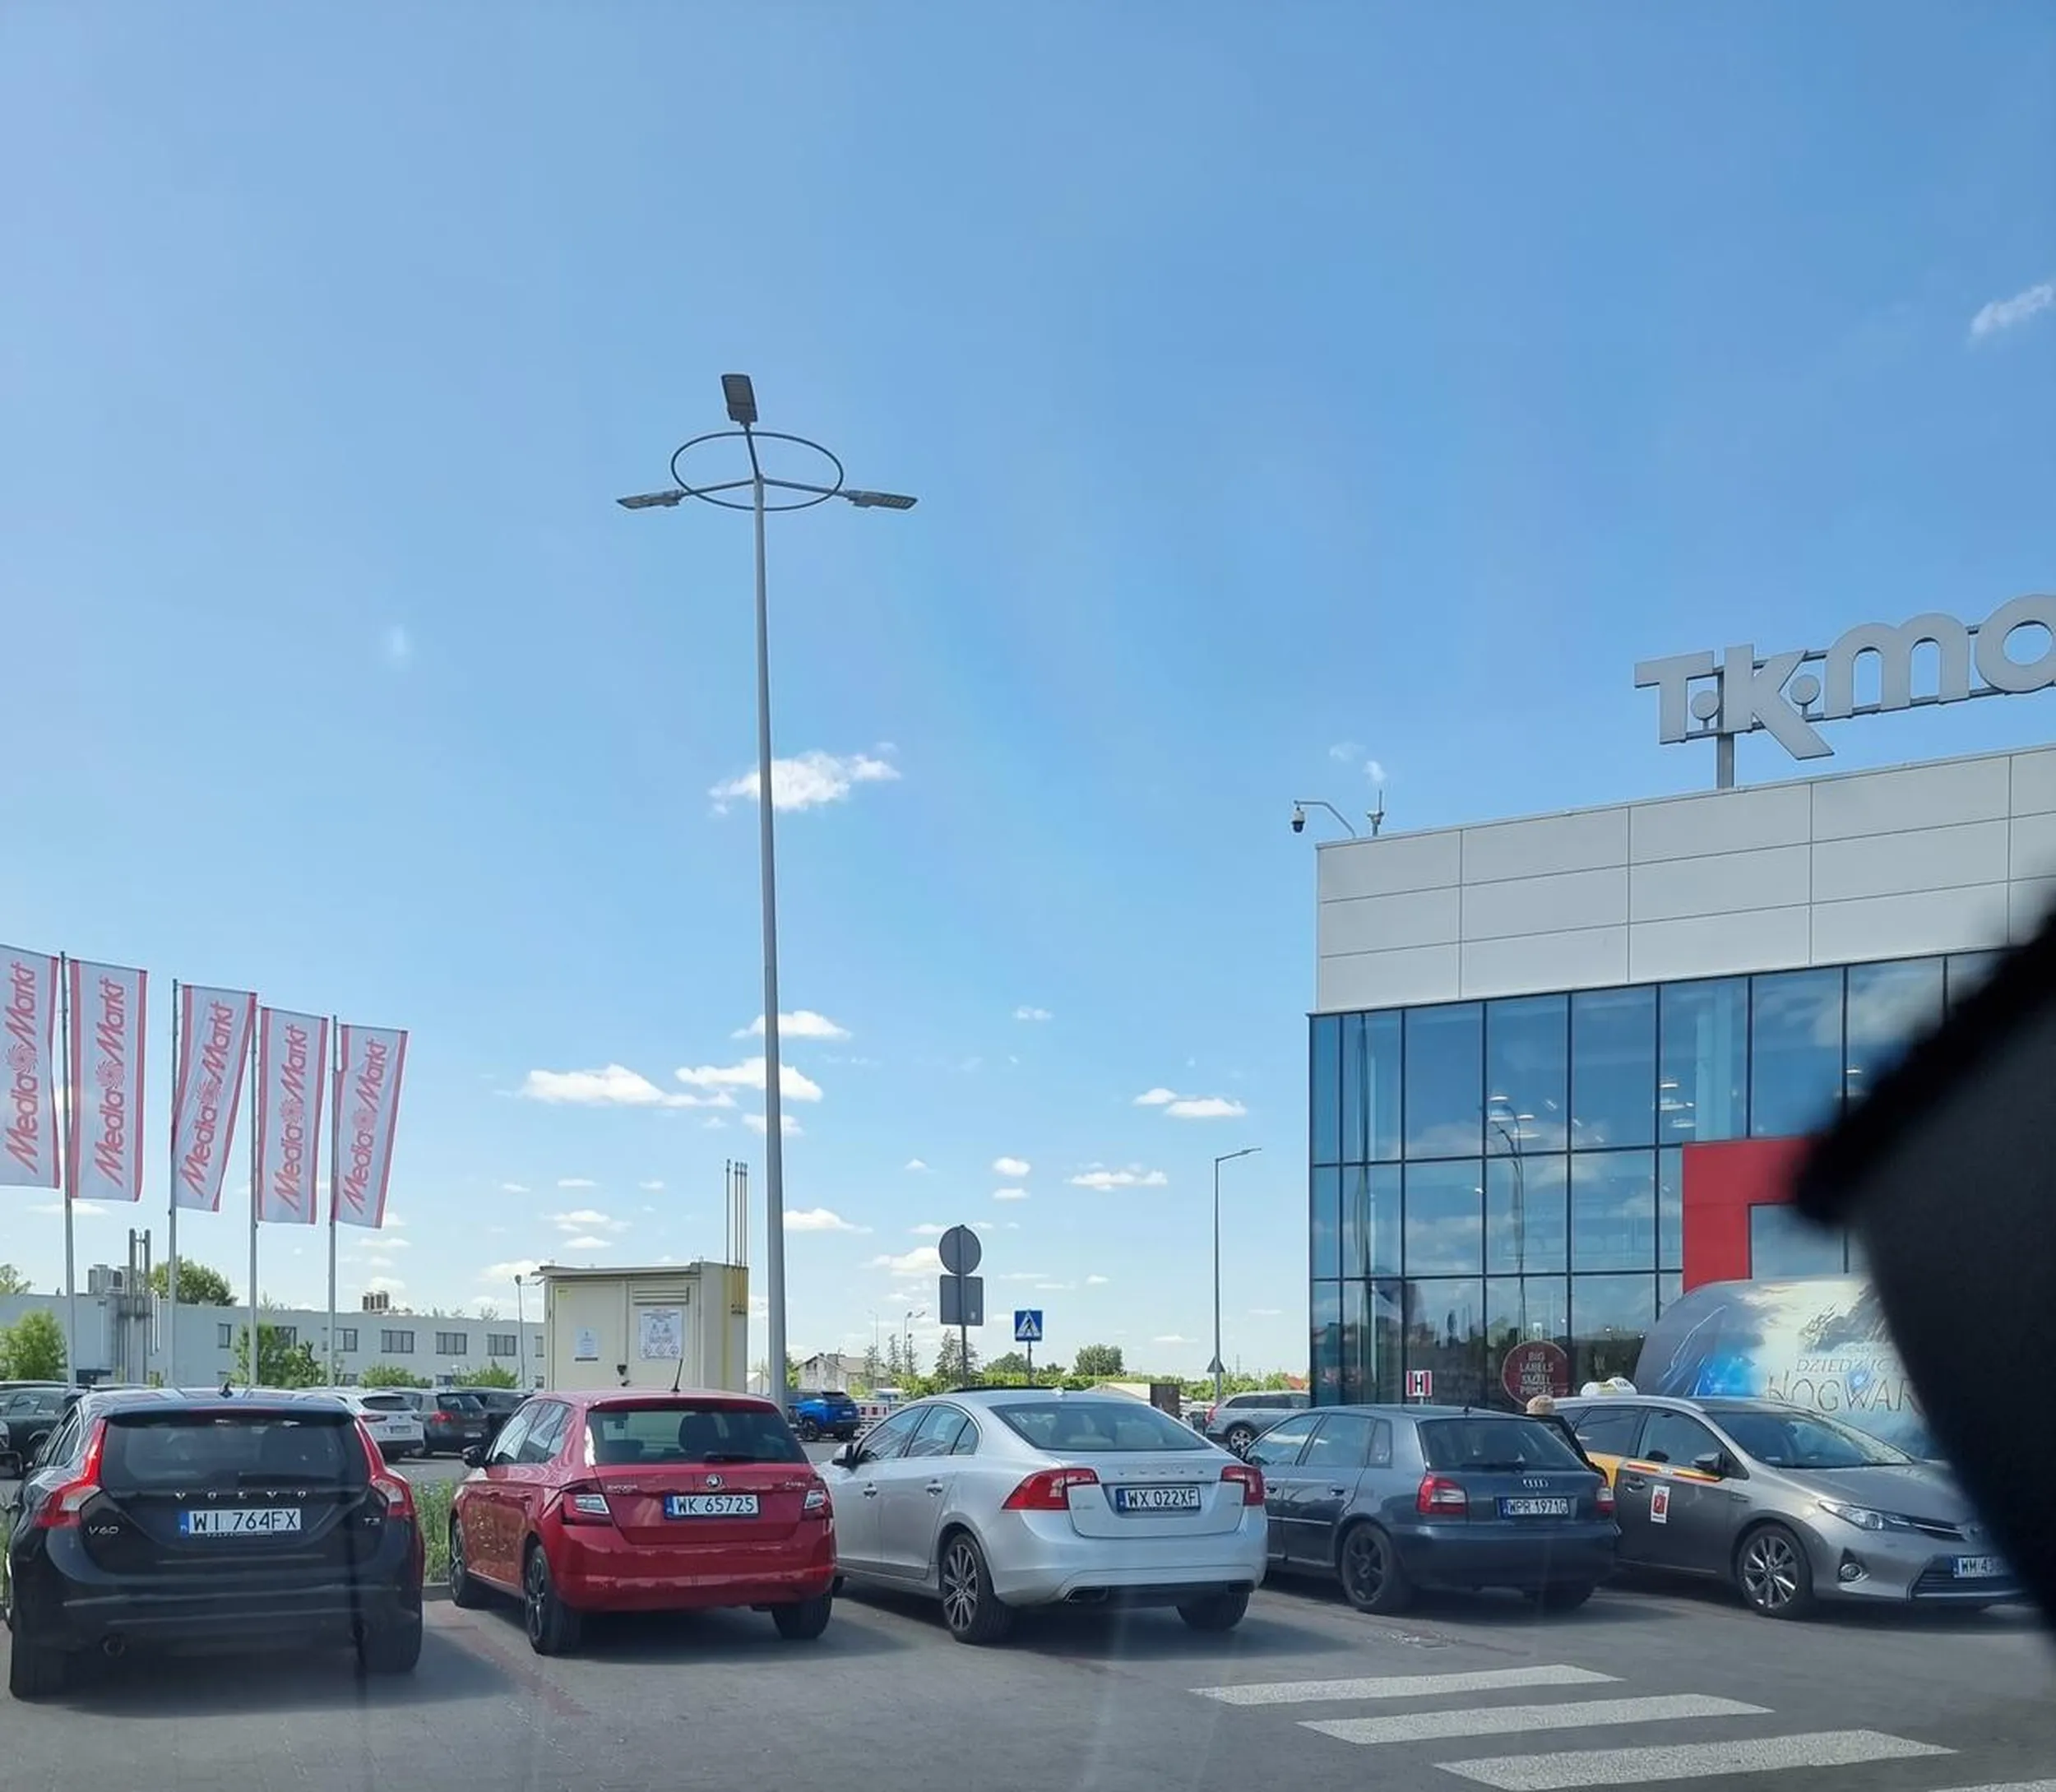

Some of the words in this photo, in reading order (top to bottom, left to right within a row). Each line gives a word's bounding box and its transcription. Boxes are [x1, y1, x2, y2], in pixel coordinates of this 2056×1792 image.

[4, 961, 38, 1052] Markt
[96, 976, 125, 1069] Markt
[179, 1106, 218, 1198] Media
[201, 1000, 234, 1084] Markt
[280, 1024, 308, 1104] Markt
[355, 1038, 387, 1112] Markt
[3, 1072, 39, 1175] Media
[95, 1087, 125, 1186] Media
[274, 1124, 303, 1211] Media
[342, 1128, 375, 1215] Media
[174, 1490, 308, 1499] VOLVO
[192, 1512, 221, 1532] WI
[233, 1511, 299, 1530] 764FX
[677, 1498, 697, 1513] WK
[705, 1497, 754, 1512] 65725
[1128, 1492, 1149, 1506] WX
[1154, 1490, 1195, 1506] 022XF
